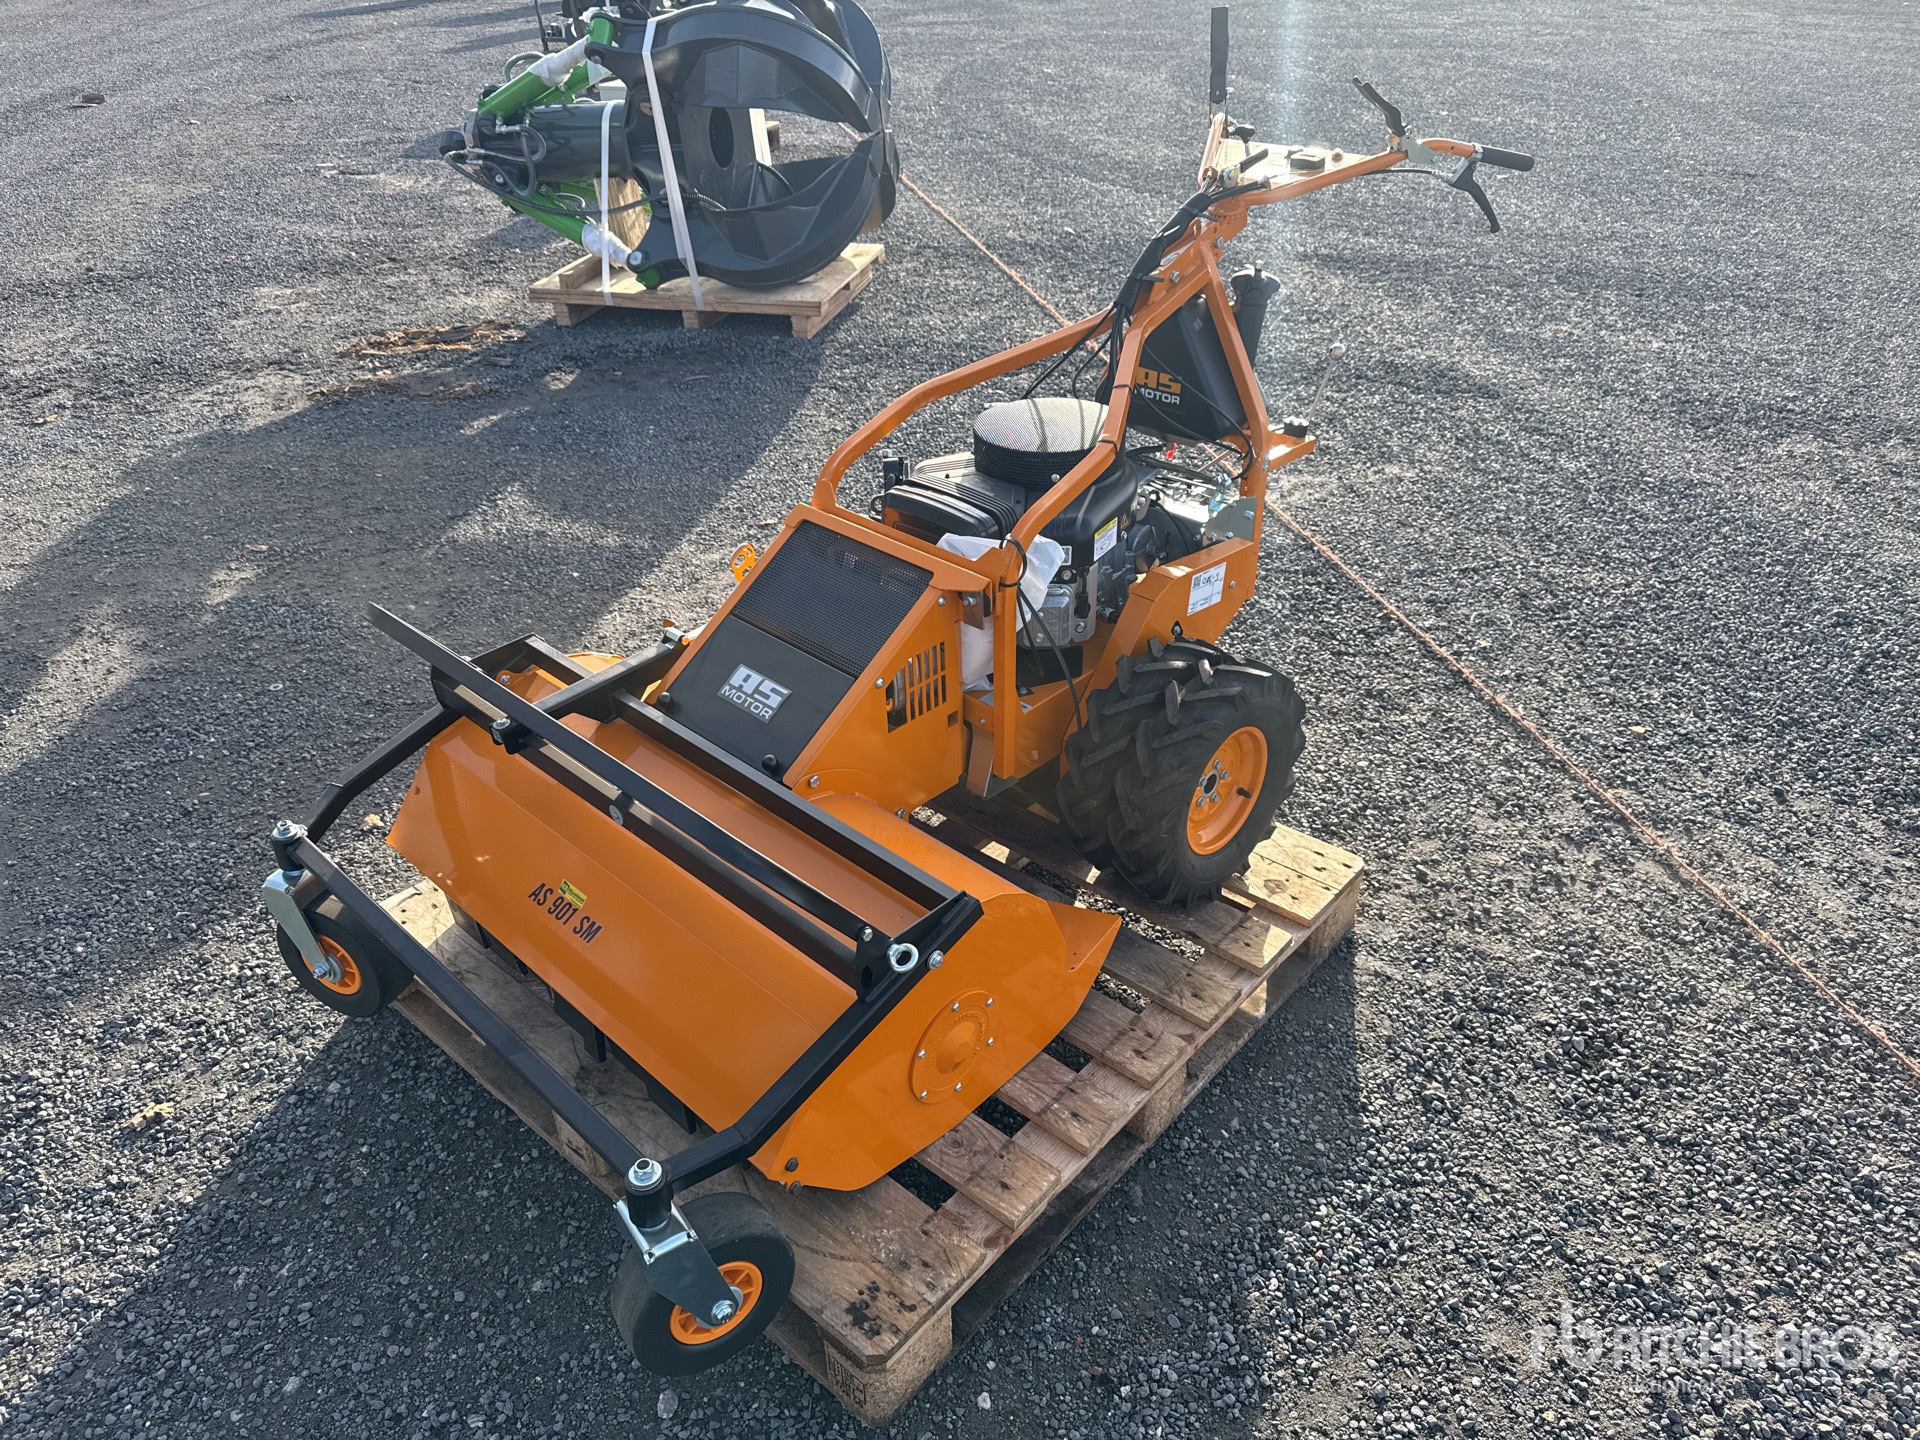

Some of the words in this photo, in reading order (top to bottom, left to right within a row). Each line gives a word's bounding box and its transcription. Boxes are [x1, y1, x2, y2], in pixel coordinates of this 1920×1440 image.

[1135, 367, 1181, 394] AS
[721, 685, 772, 719] MOTOR
[729, 666, 788, 708] AS
[528, 882, 553, 906] AS
[548, 896, 578, 925] 901
[573, 916, 603, 944] SM
